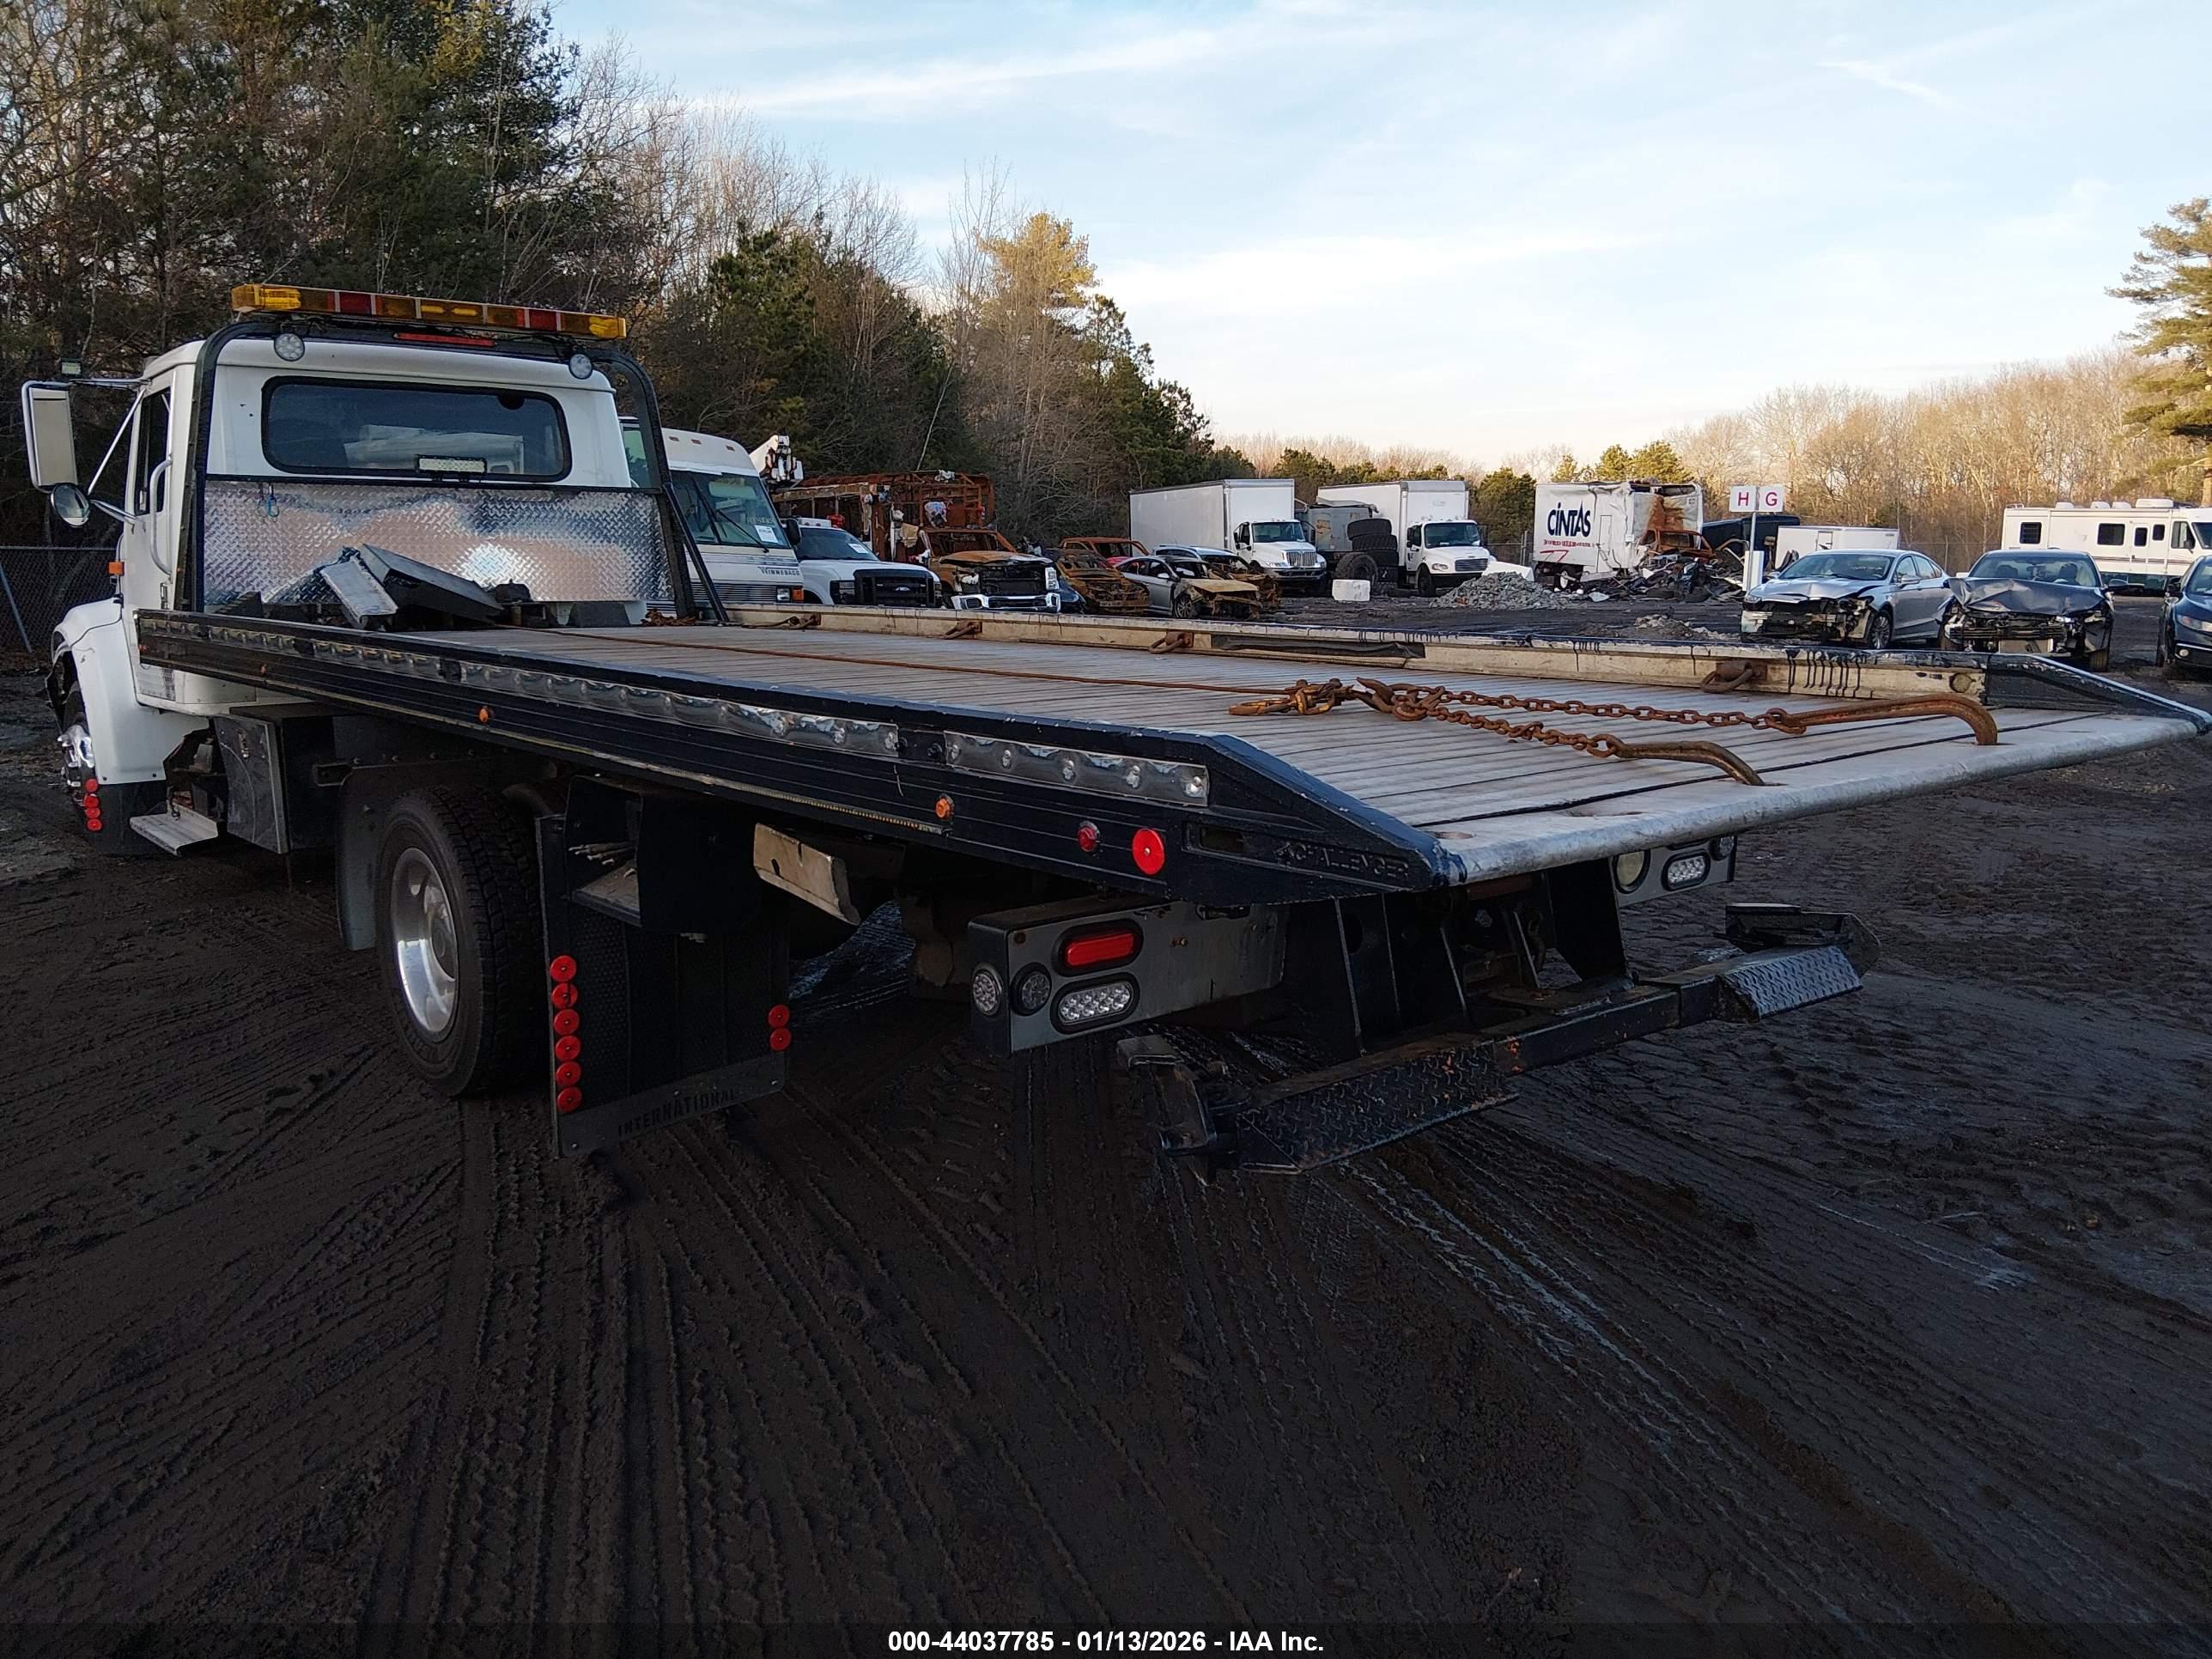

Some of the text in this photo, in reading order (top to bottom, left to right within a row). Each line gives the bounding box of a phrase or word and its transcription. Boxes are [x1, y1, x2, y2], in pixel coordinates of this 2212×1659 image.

[1737, 492, 1749, 506] H
[1765, 492, 1778, 506] G
[1547, 501, 1591, 537] CINTAS
[617, 1088, 736, 1136] INTERNATIONAL
